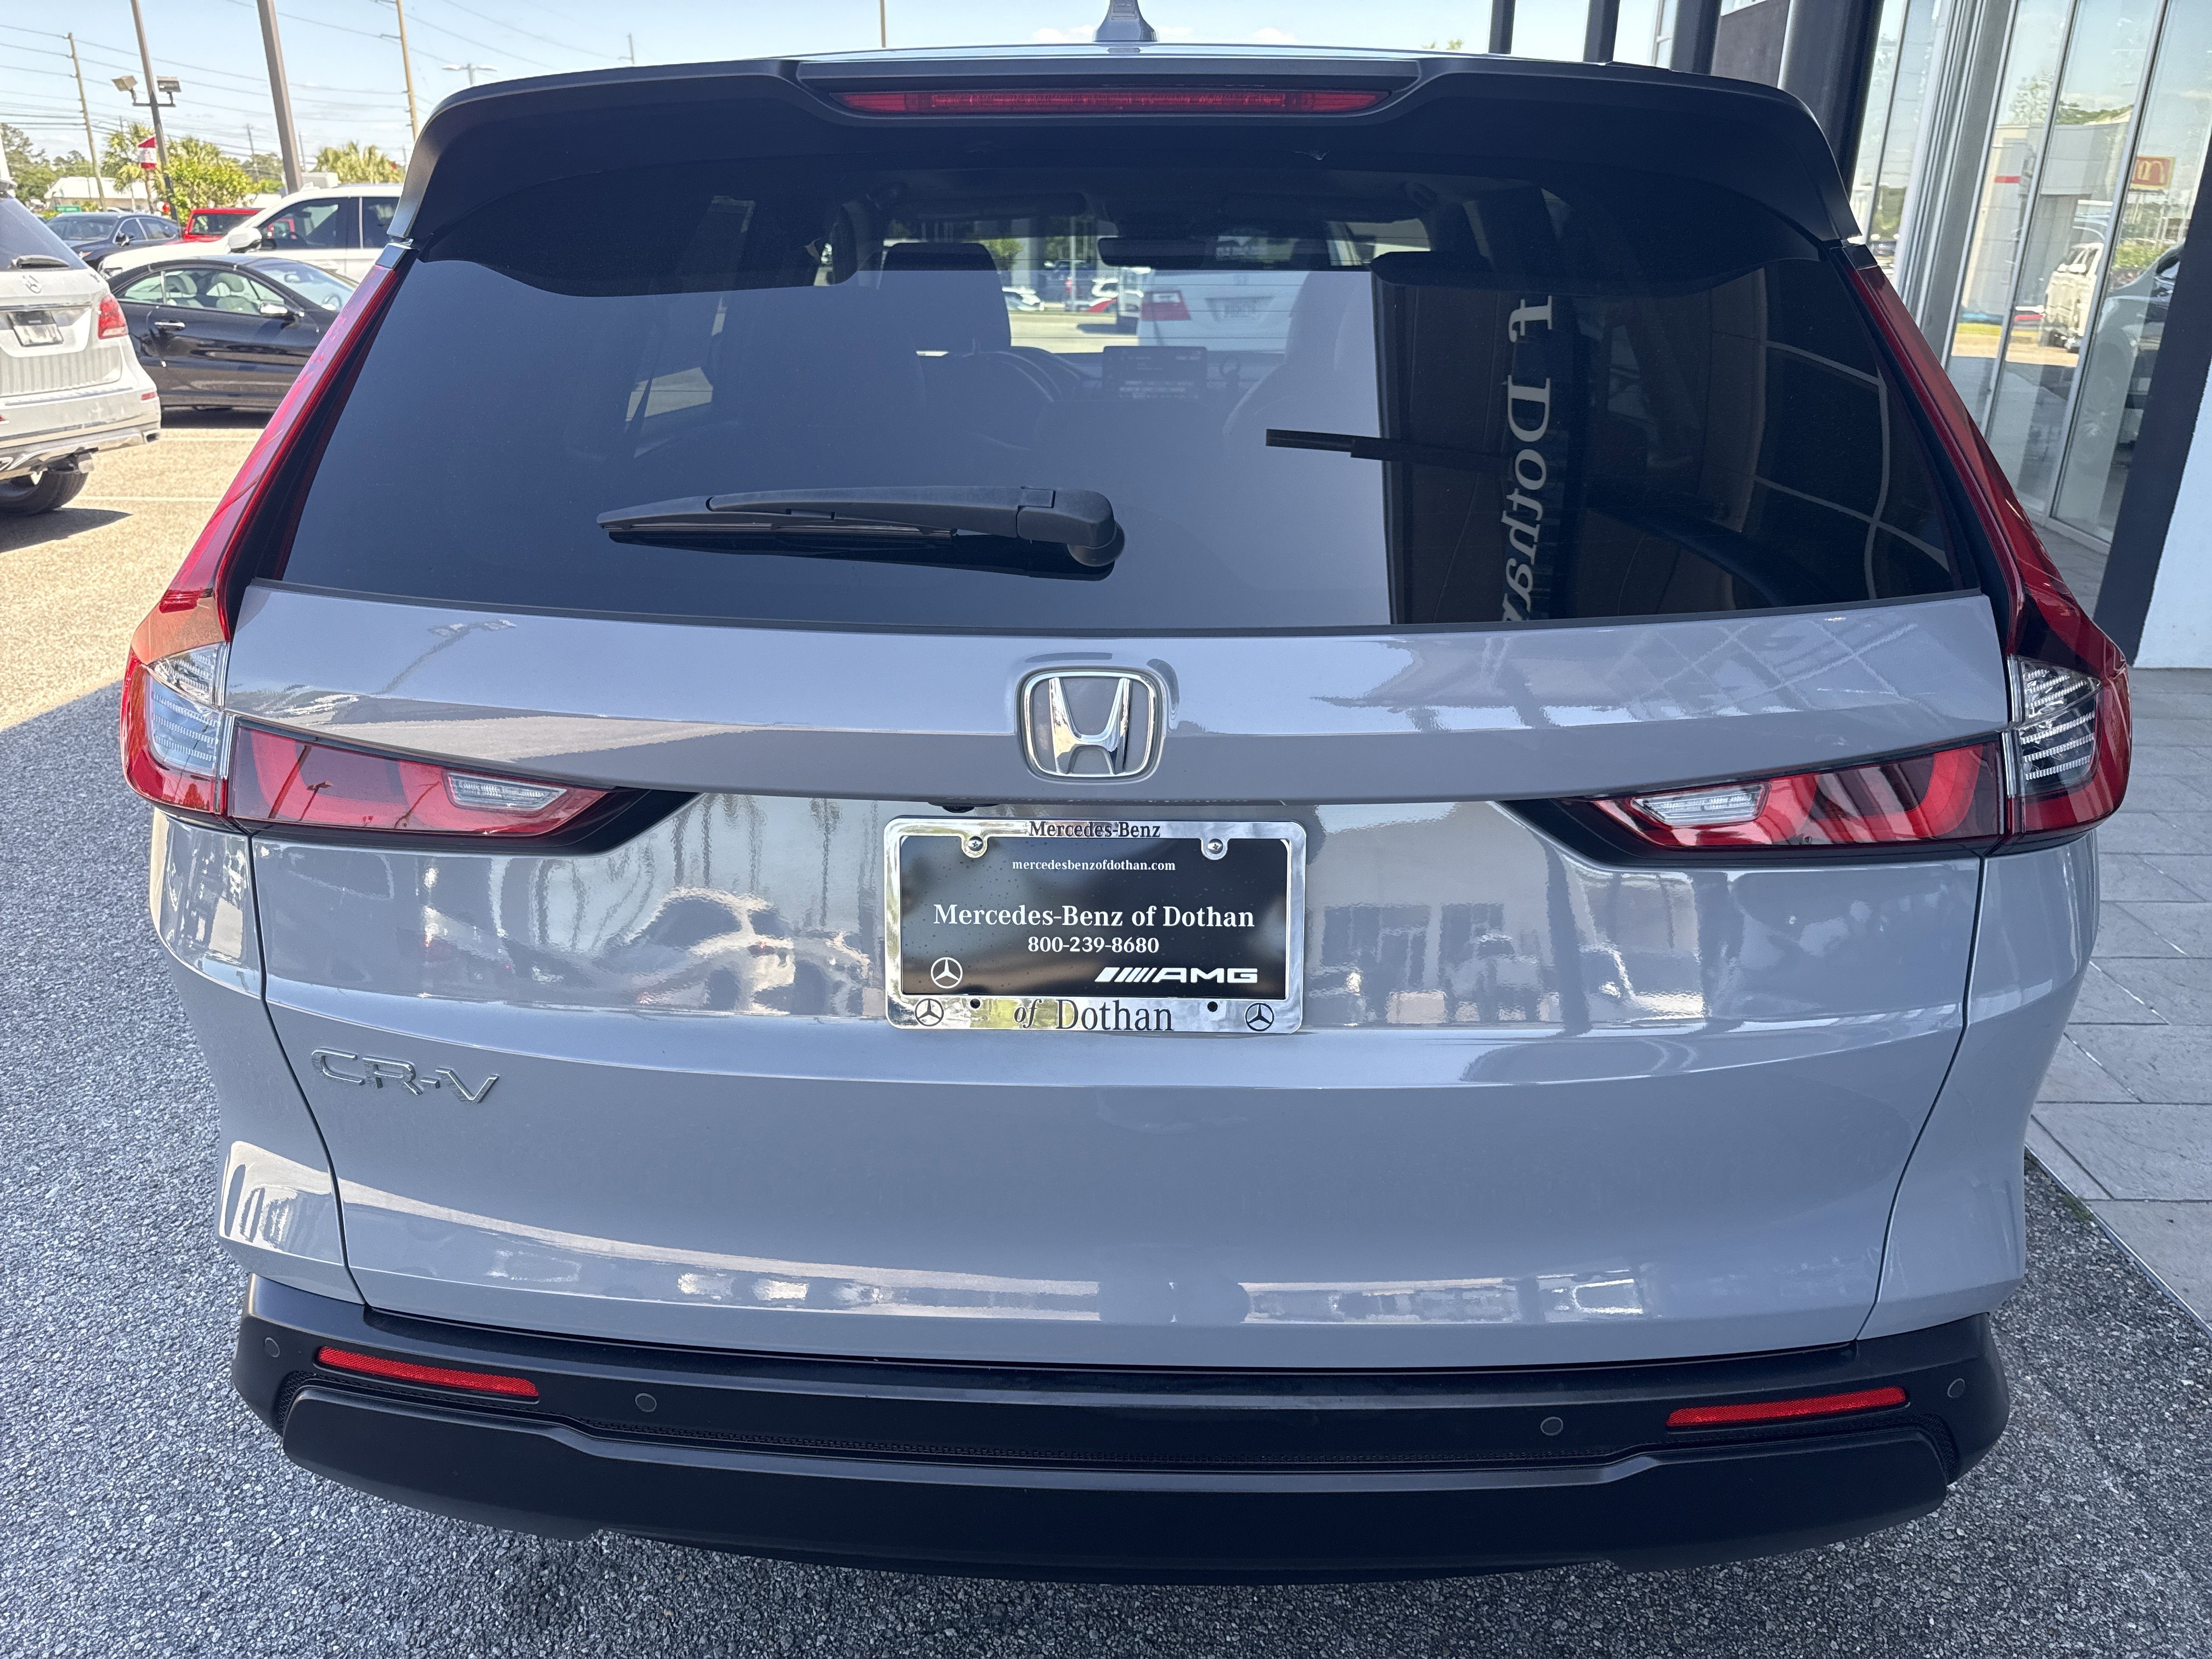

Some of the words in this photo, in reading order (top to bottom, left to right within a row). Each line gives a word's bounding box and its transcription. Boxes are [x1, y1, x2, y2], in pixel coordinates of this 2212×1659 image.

[1029, 821, 1161, 838] Mercedes-Benz
[1012, 859, 1176, 872] mercedesbenzofdothan.com
[933, 904, 1124, 927] Mercedes-Benz
[1131, 905, 1157, 927] of
[1163, 906, 1255, 928] Dothan
[1028, 936, 1159, 954] 800-239-8680
[1014, 998, 1043, 1029] of
[1056, 1000, 1175, 1032] Dothan
[311, 1047, 500, 1104] CR-V
